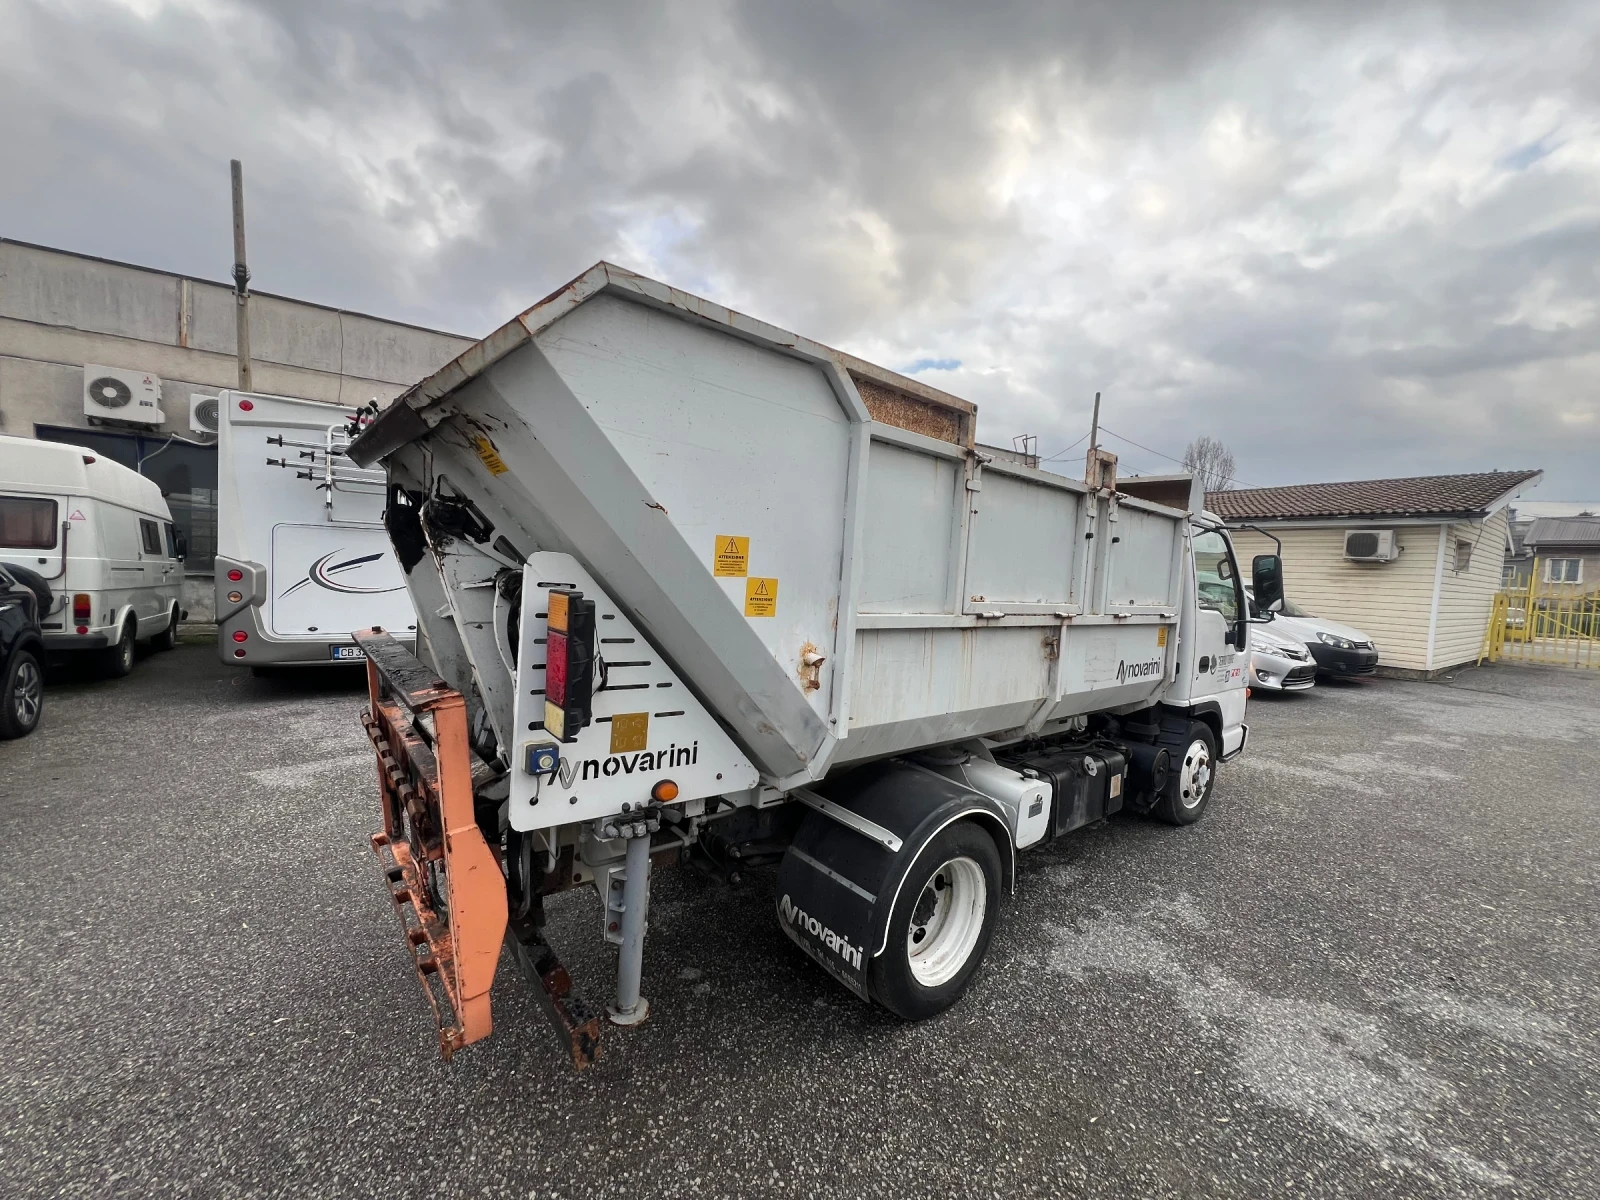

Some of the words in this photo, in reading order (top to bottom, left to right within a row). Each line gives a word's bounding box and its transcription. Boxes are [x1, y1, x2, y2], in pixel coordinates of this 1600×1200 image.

[341, 648, 353, 656] CB
[1128, 657, 1161, 678] novarini
[582, 740, 698, 781] novarini
[798, 908, 864, 972] novarini
